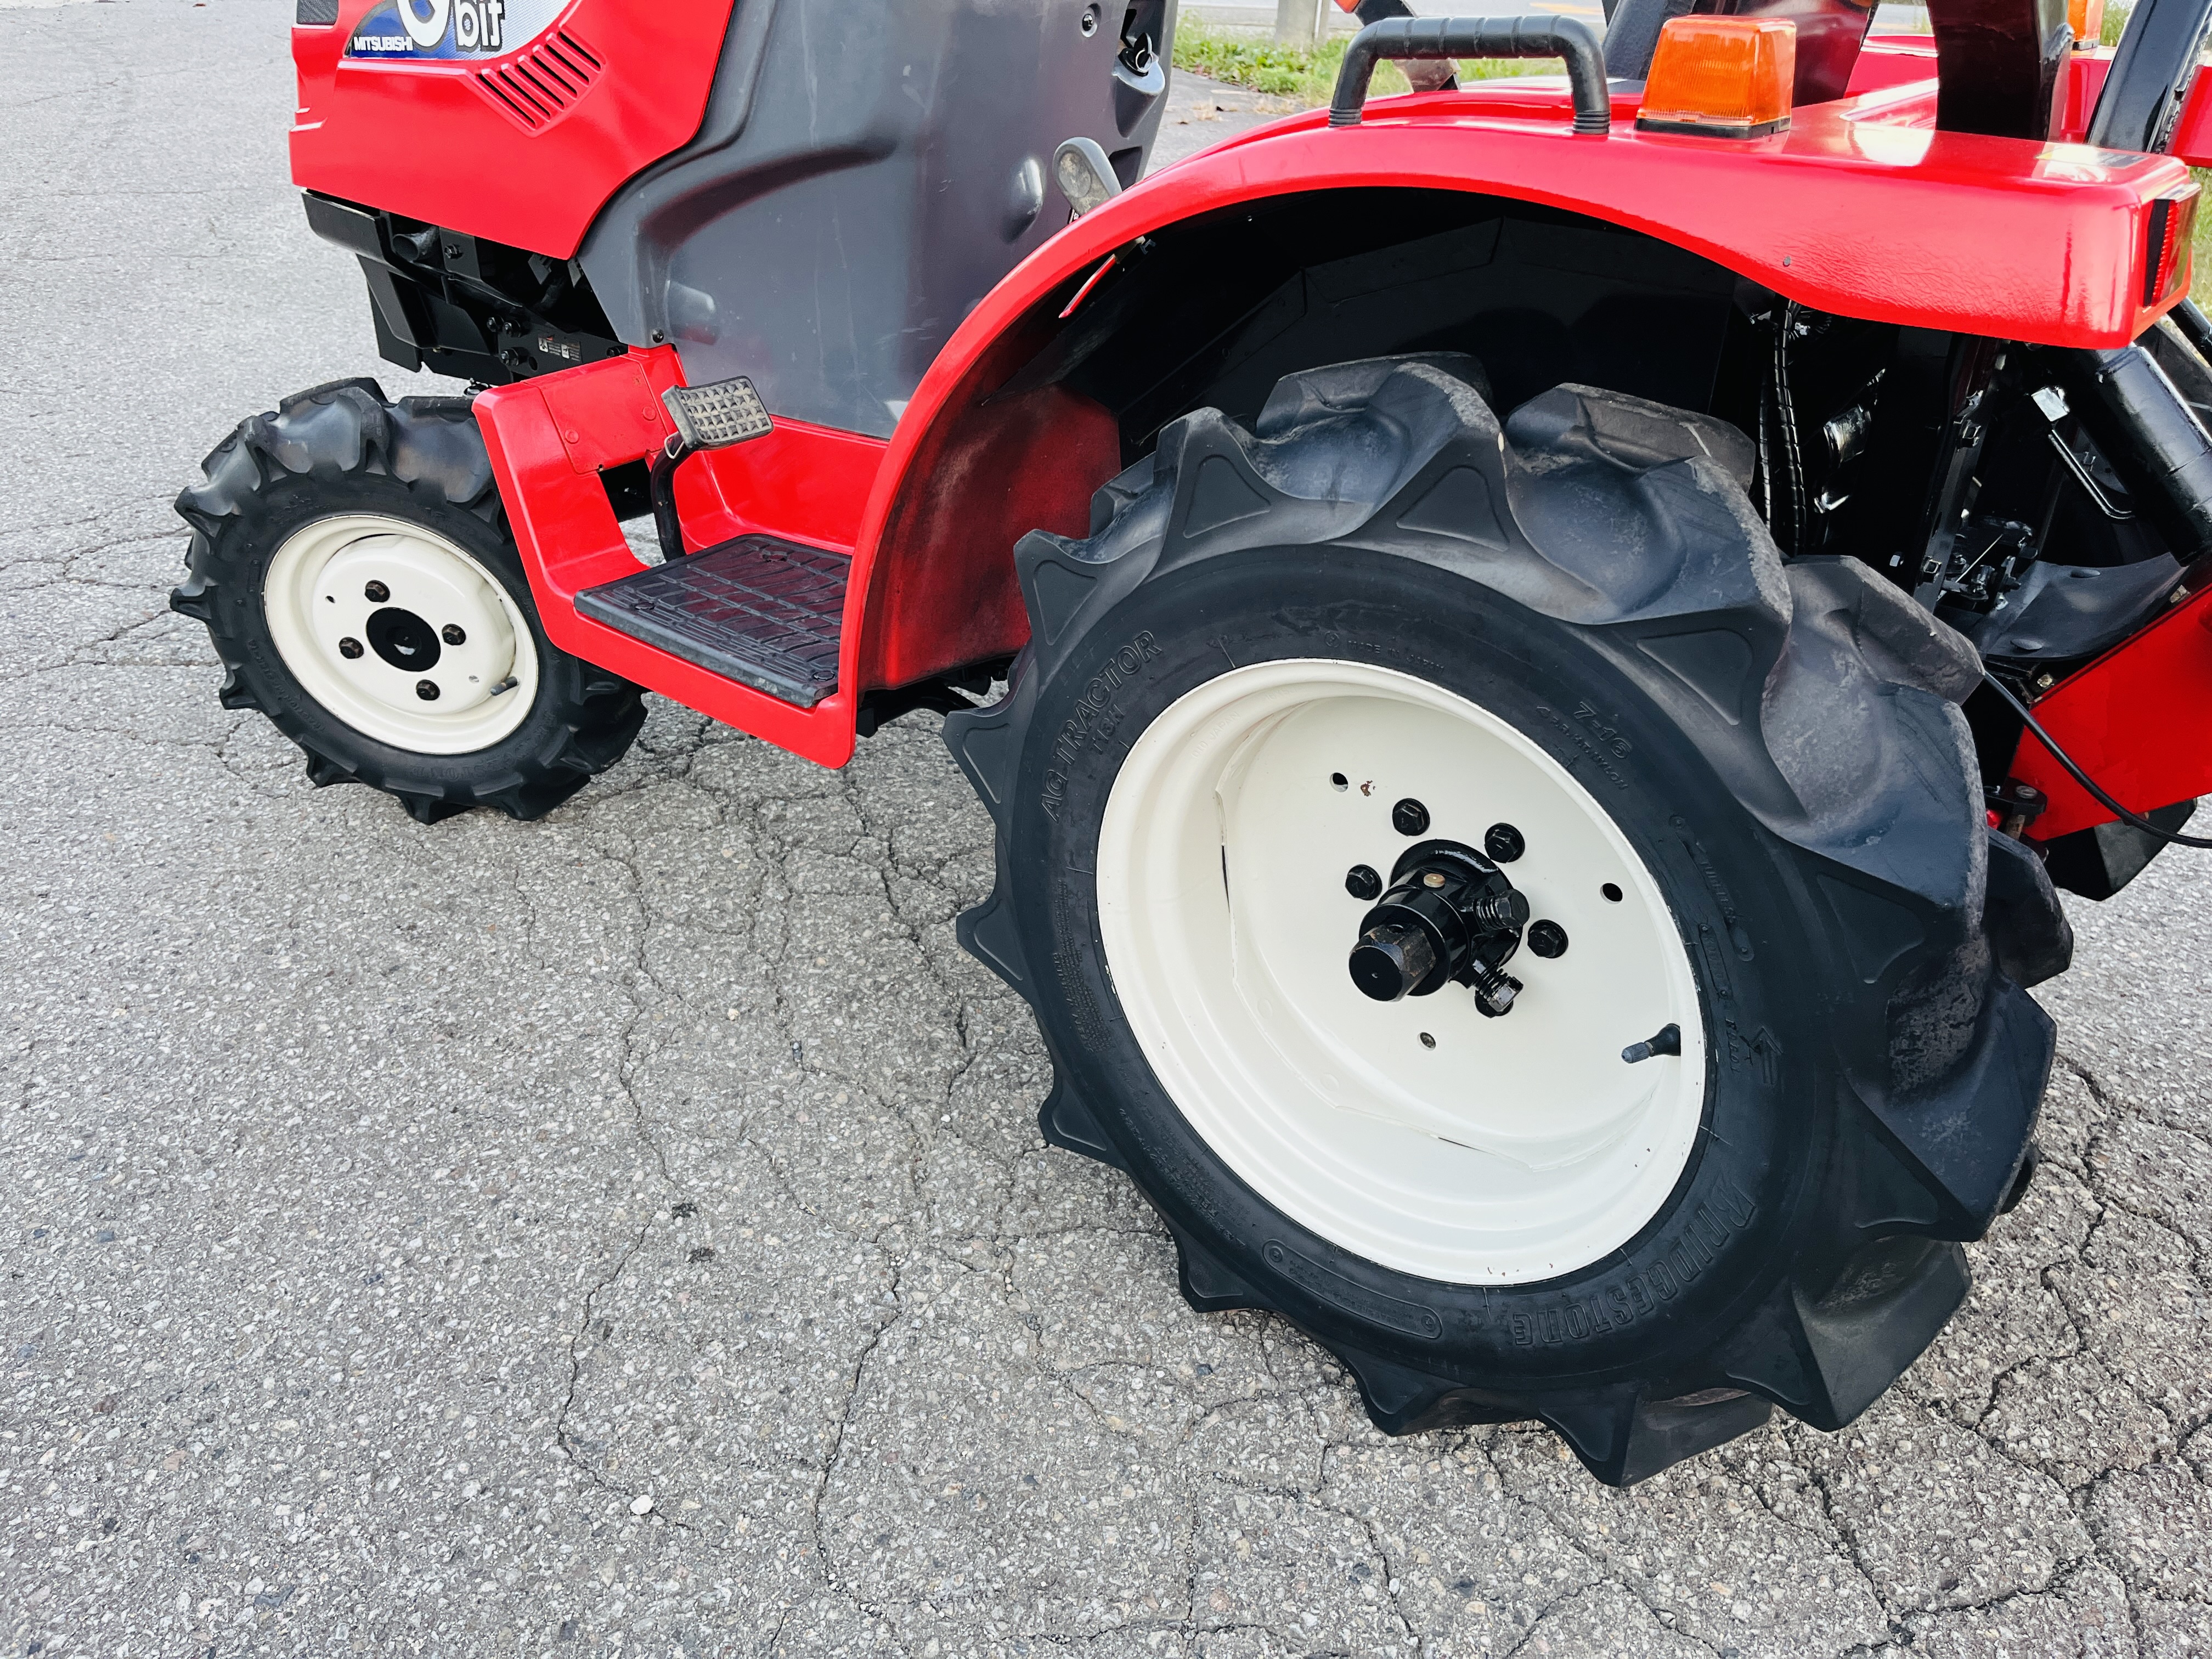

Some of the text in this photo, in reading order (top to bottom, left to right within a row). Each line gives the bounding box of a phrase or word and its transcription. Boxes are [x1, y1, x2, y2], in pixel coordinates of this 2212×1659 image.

[354, 36, 413, 52] MITSUBISHI
[1041, 630, 1163, 823] AG TRACTOR
[1207, 712, 1241, 742] JAPAN
[1573, 699, 1633, 759] 7-16
[1513, 1170, 1756, 1346] BRIDGESTONE
